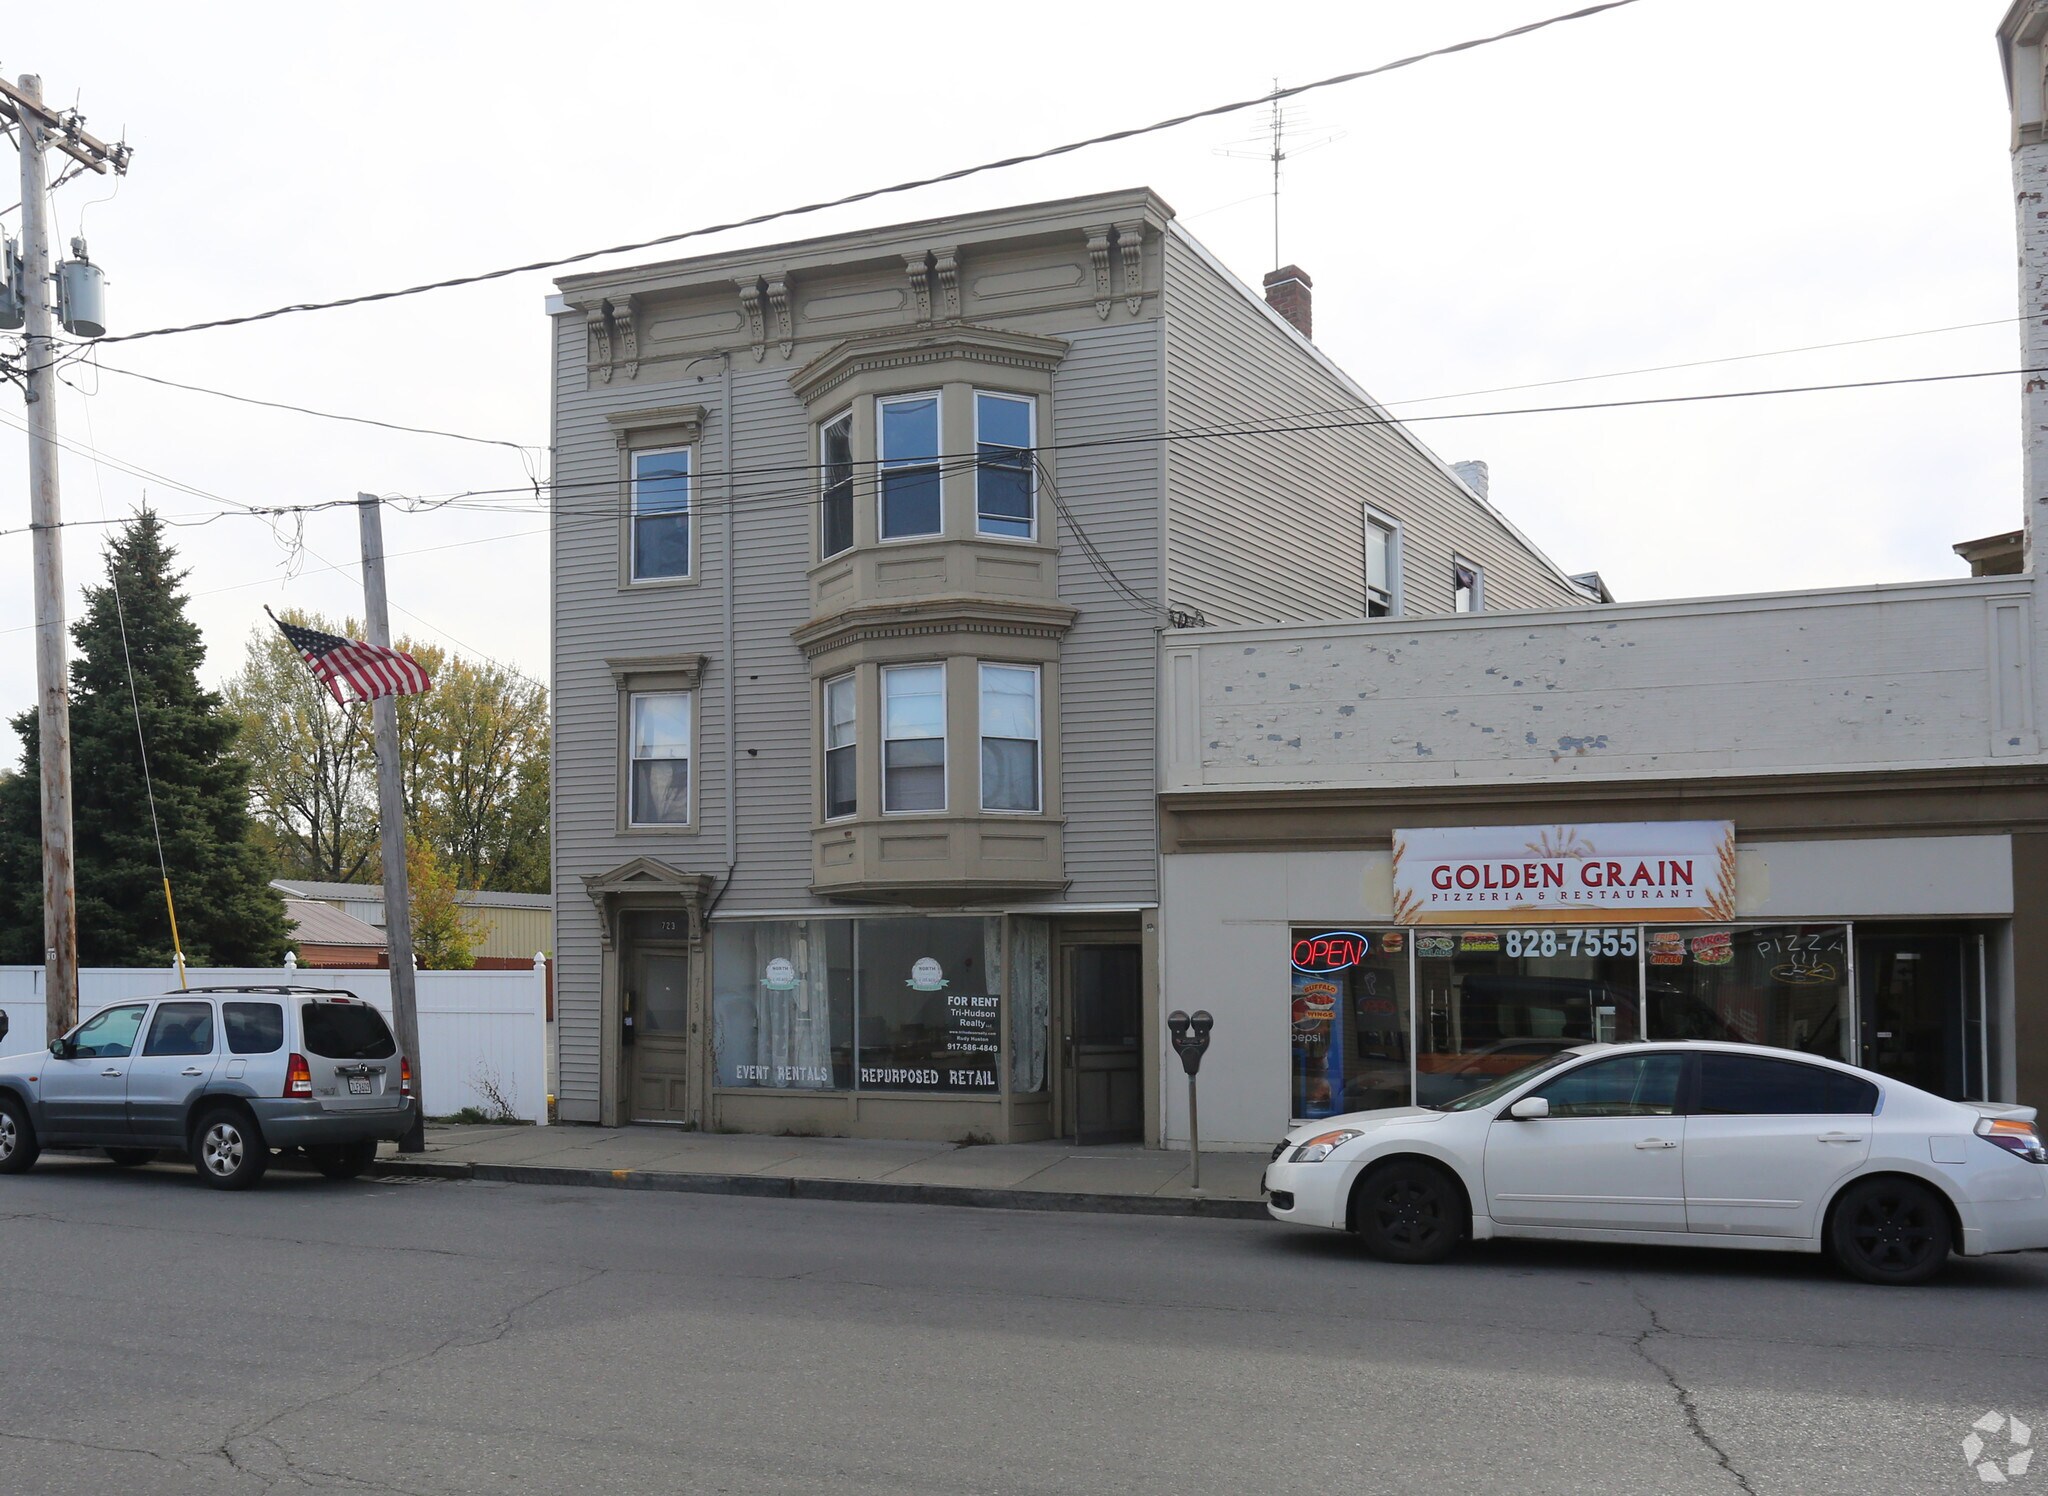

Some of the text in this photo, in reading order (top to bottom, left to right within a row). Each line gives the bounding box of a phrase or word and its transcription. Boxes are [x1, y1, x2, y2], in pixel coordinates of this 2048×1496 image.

[1431, 860, 1693, 890] GOLDEN GRAIN
[1432, 889, 1693, 901] PIZZERIA & RESTAURANT
[661, 921, 676, 930] 723
[1506, 929, 1637, 958] 828-7555
[1692, 932, 1731, 953] GYROS
[1757, 934, 1843, 959] PIZZA
[1293, 940, 1363, 965] OPEN
[1418, 948, 1453, 957] SALADS
[1650, 955, 1683, 965] CHICKEN
[1304, 984, 1337, 994] BUFFALO
[947, 996, 999, 1007] FOR RENT
[950, 1008, 996, 1017] Tri-Hudson
[959, 1019, 986, 1029] Realty
[947, 1043, 998, 1052] 917-586-4849
[736, 1065, 828, 1081] EVENT RENTALS
[861, 1068, 996, 1085] REPURPOSED RETAIL
